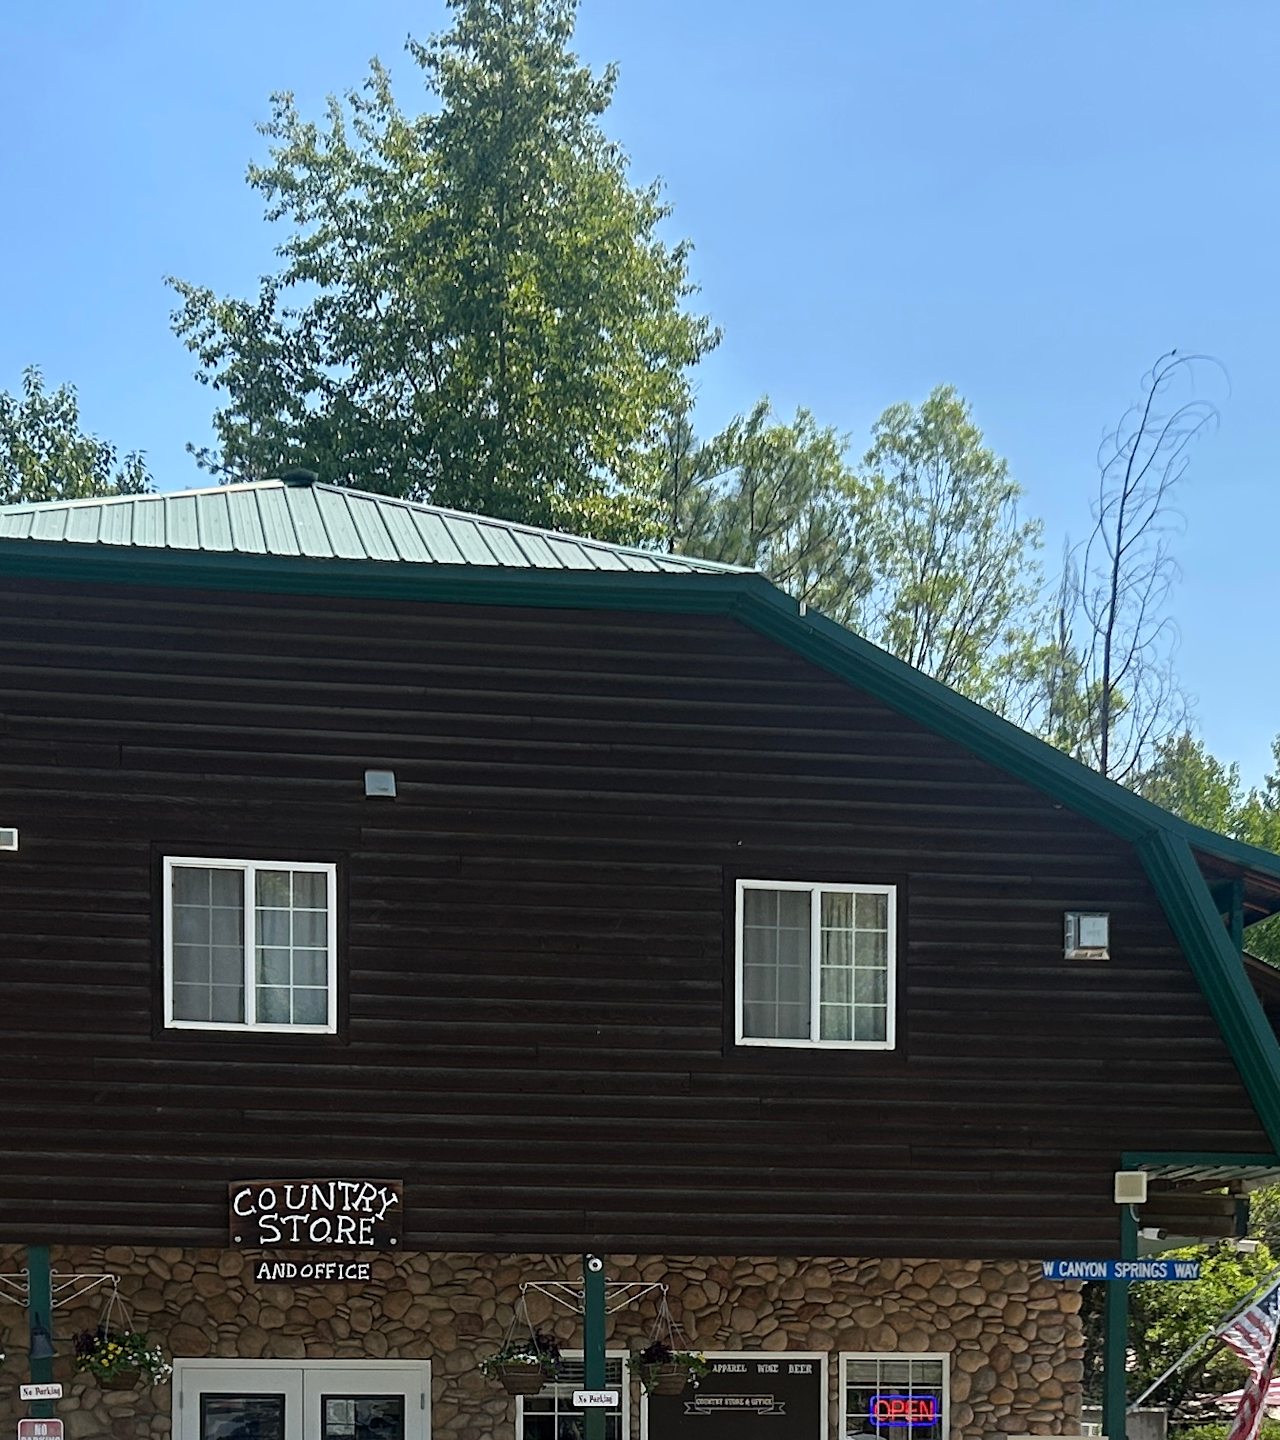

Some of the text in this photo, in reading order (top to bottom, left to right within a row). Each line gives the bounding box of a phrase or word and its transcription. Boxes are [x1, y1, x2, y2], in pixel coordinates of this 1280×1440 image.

[233, 1181, 398, 1220] COUNTRY
[258, 1213, 375, 1245] STORE
[257, 1263, 370, 1280] AND OFFICE
[1043, 1261, 1200, 1278] W CANYON SPRINGS WAY
[712, 1364, 812, 1374] APPAREL WINE BEER
[35, 1386, 60, 1397] Parking
[874, 1400, 934, 1421] OPEN
[34, 1423, 48, 1435] NO
